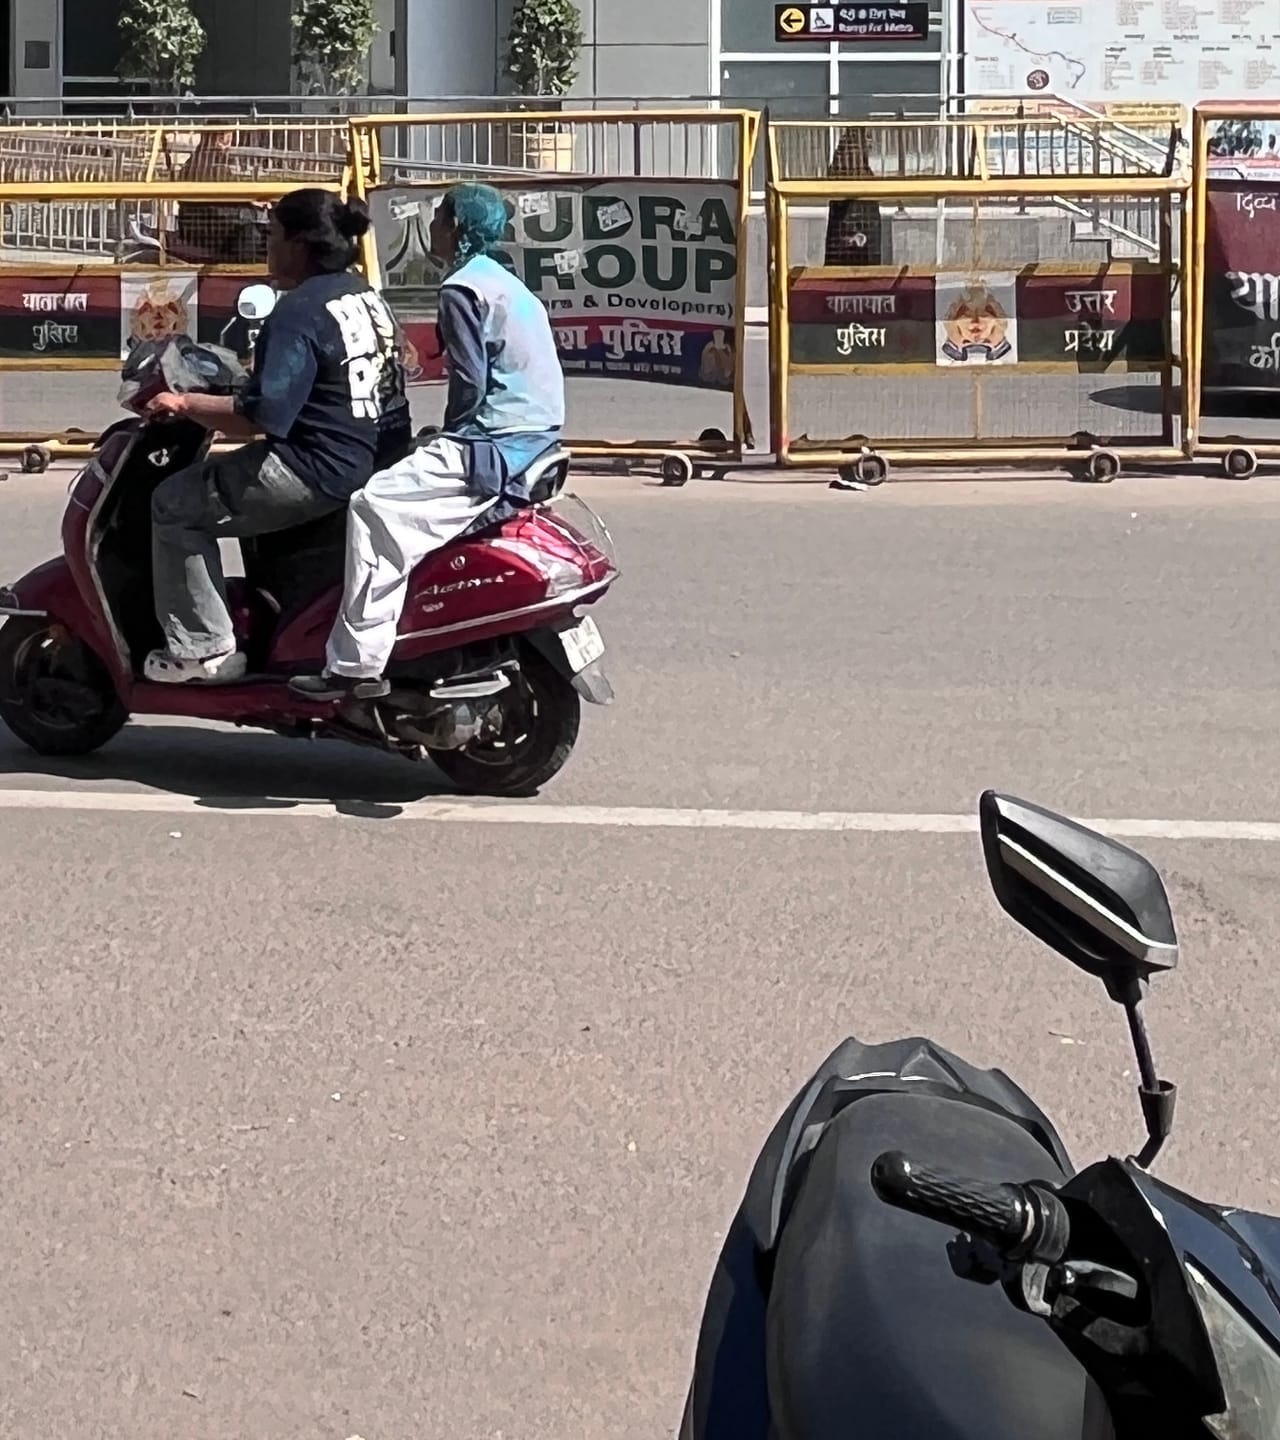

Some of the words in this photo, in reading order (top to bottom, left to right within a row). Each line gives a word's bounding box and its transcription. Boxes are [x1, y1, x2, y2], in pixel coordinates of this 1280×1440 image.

[825, 294, 896, 315] यातायात
[1063, 289, 1119, 314] उत्तर
[599, 319, 685, 359] पुलिस
[835, 322, 887, 354] पुलिस
[1063, 321, 1114, 353] प्रदेश
